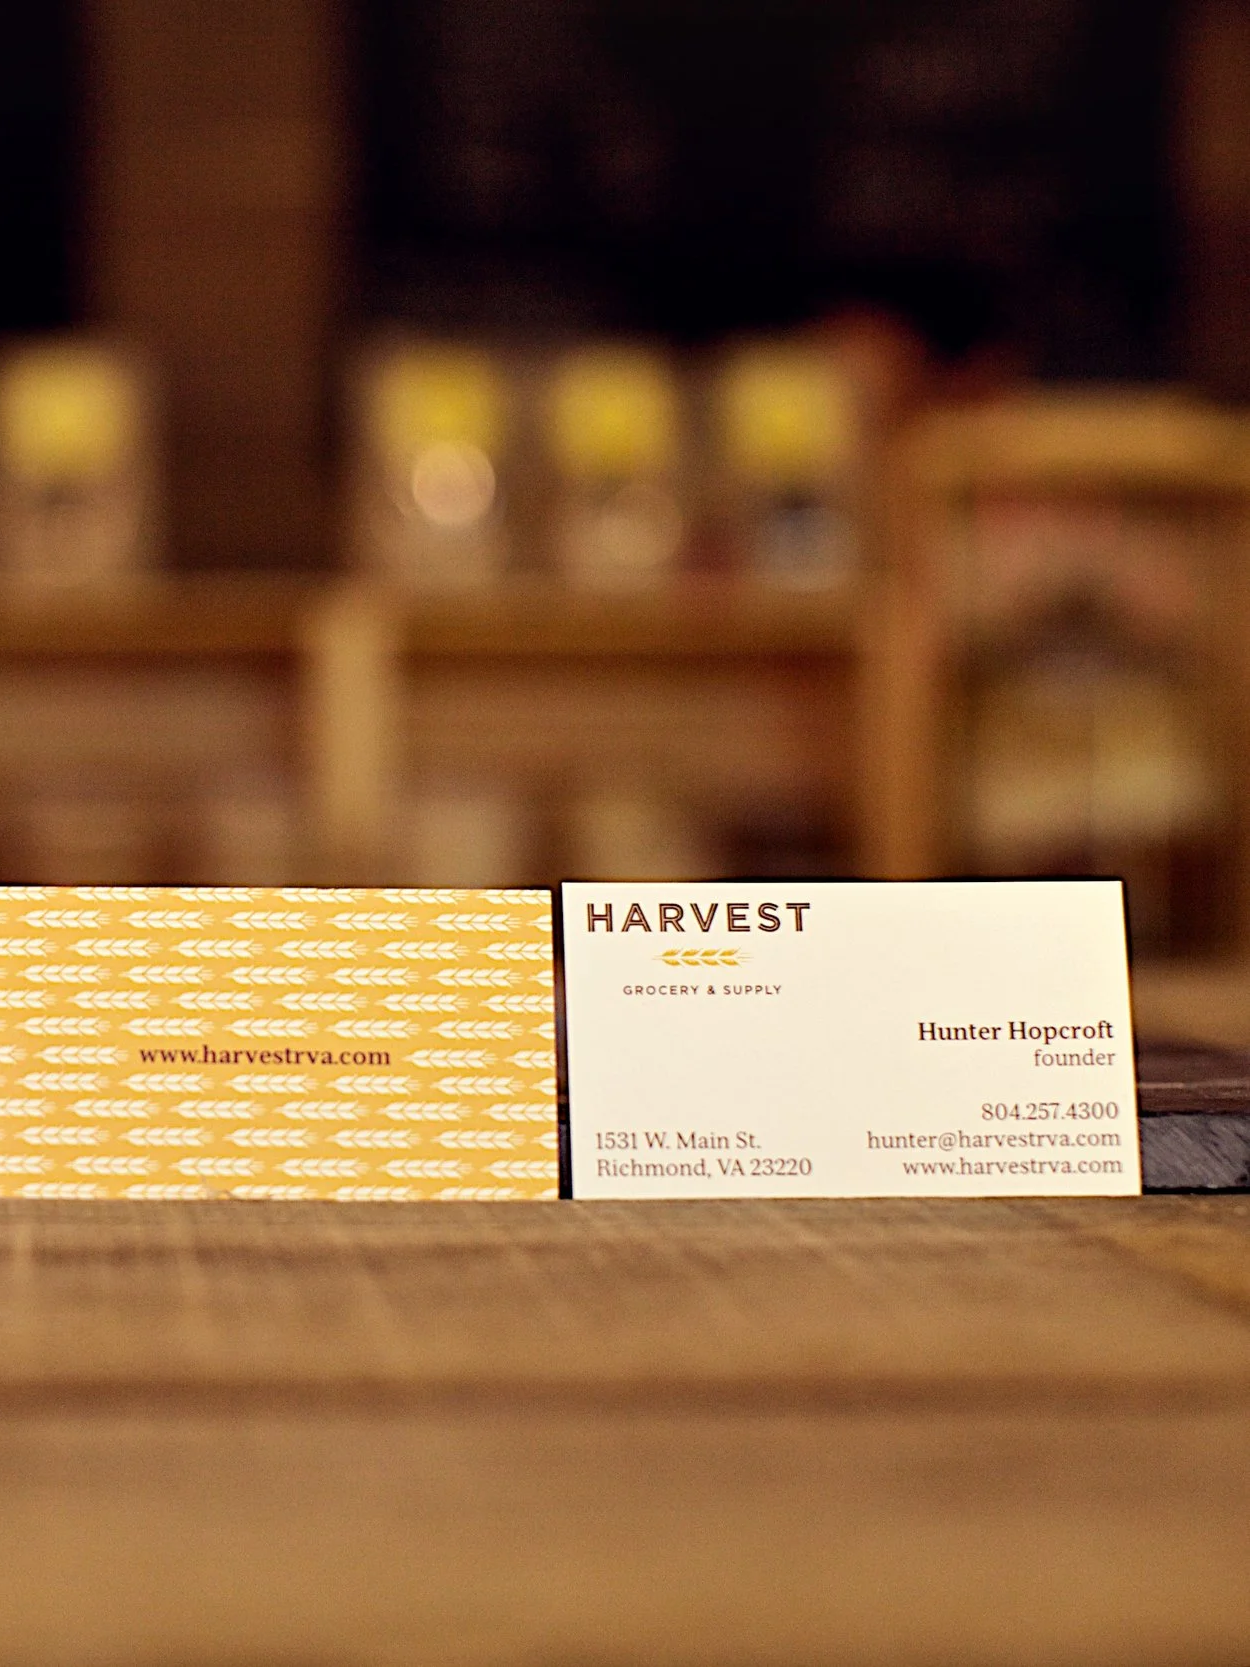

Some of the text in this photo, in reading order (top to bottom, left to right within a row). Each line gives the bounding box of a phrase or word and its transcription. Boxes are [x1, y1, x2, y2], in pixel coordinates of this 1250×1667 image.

[587, 902, 811, 933] HARVEST
[623, 985, 781, 995] GROCERY & SUPPLY
[918, 1020, 1114, 1045] Hunter Hopcroft
[139, 1044, 391, 1065] www.harvestrva.com
[1033, 1048, 1116, 1067] founder
[982, 1102, 1119, 1120] 804.257.4300
[596, 1131, 761, 1150] 1531 W. Main St.
[867, 1130, 1121, 1151] hunter@harvestrva.com
[597, 1158, 812, 1179] Richmond, VA 23220
[902, 1157, 1122, 1175] www.harvestrva.com
